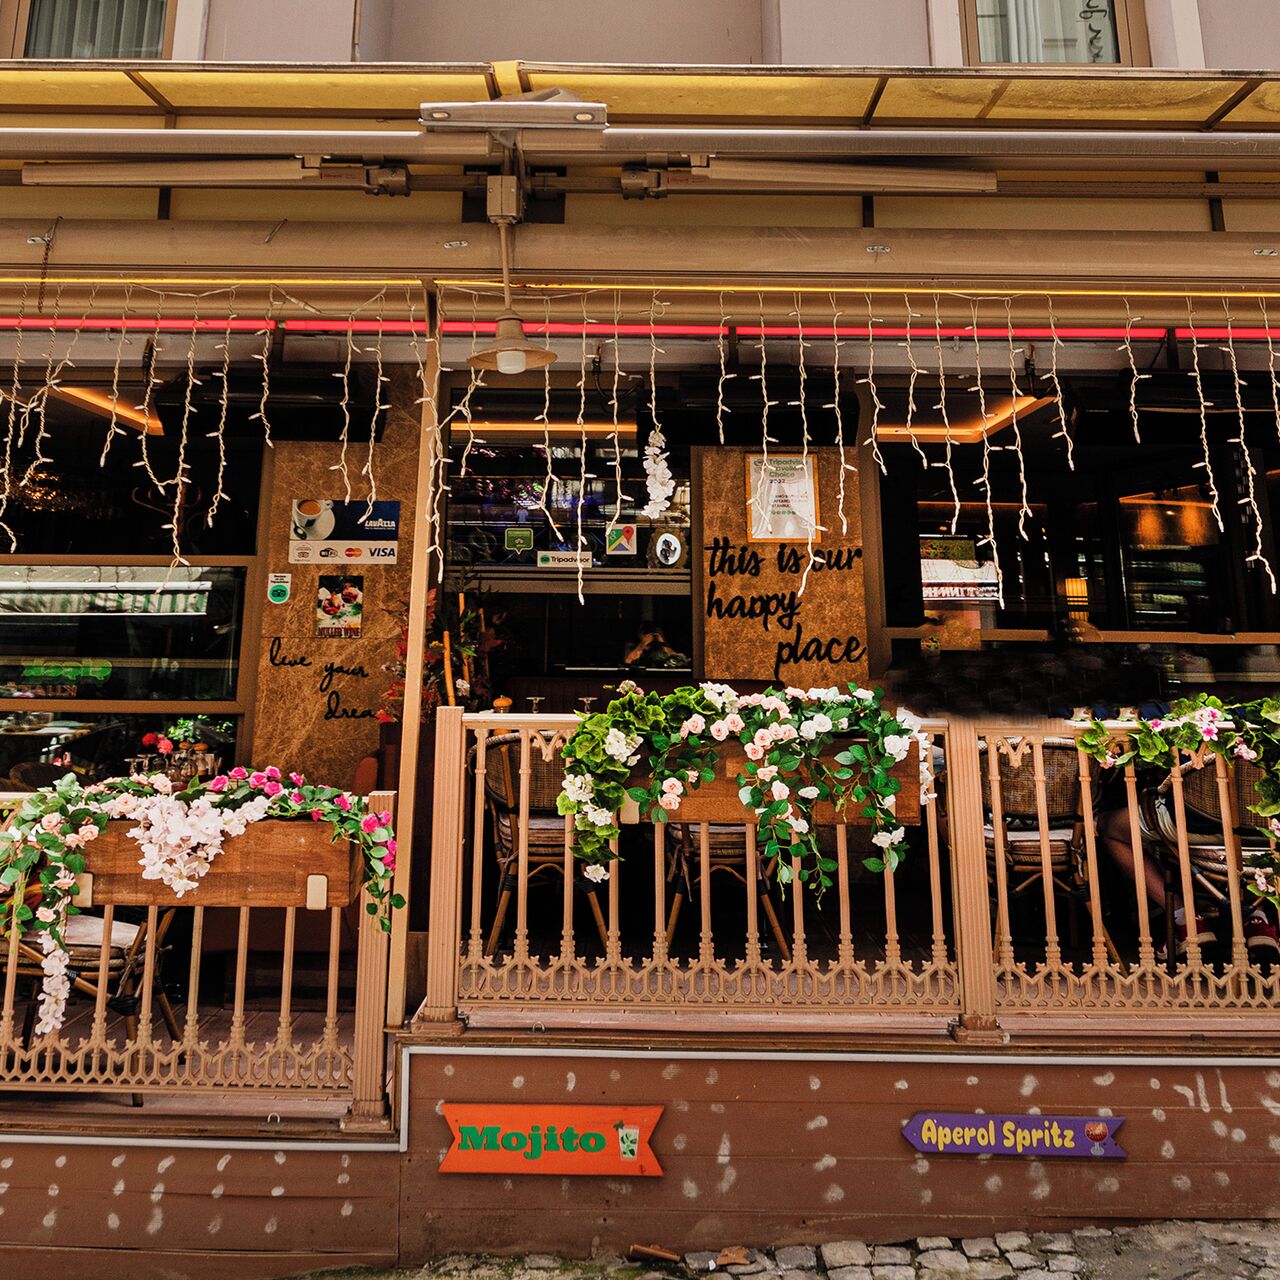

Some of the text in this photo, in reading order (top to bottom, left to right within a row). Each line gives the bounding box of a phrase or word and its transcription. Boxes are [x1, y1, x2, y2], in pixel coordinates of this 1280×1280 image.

[368, 547, 396, 558] VISA
[704, 536, 863, 578] this is our
[707, 580, 803, 632] happy
[774, 622, 867, 680] place
[320, 661, 369, 693] your
[458, 1124, 606, 1160] Mojito
[921, 1118, 1076, 1153] Aperol Spritz
